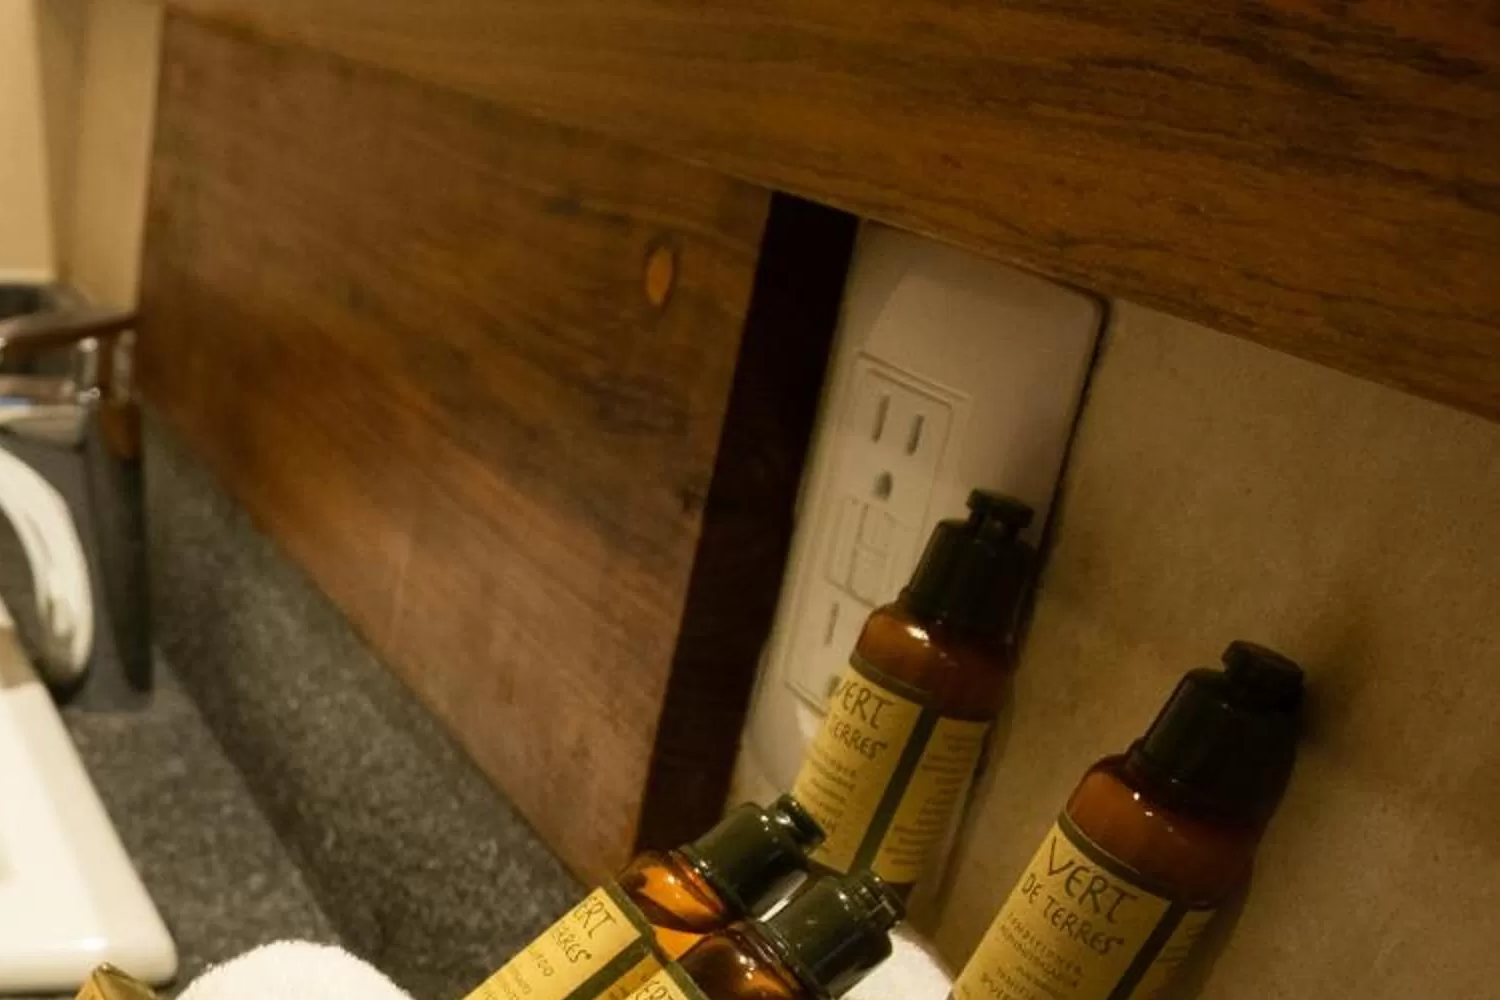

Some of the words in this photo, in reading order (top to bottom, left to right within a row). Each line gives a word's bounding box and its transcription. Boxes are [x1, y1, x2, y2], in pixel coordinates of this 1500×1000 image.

[1021, 874, 1043, 904] DE
[1043, 895, 1125, 955] TERRES
[1047, 835, 1139, 924] VERT
